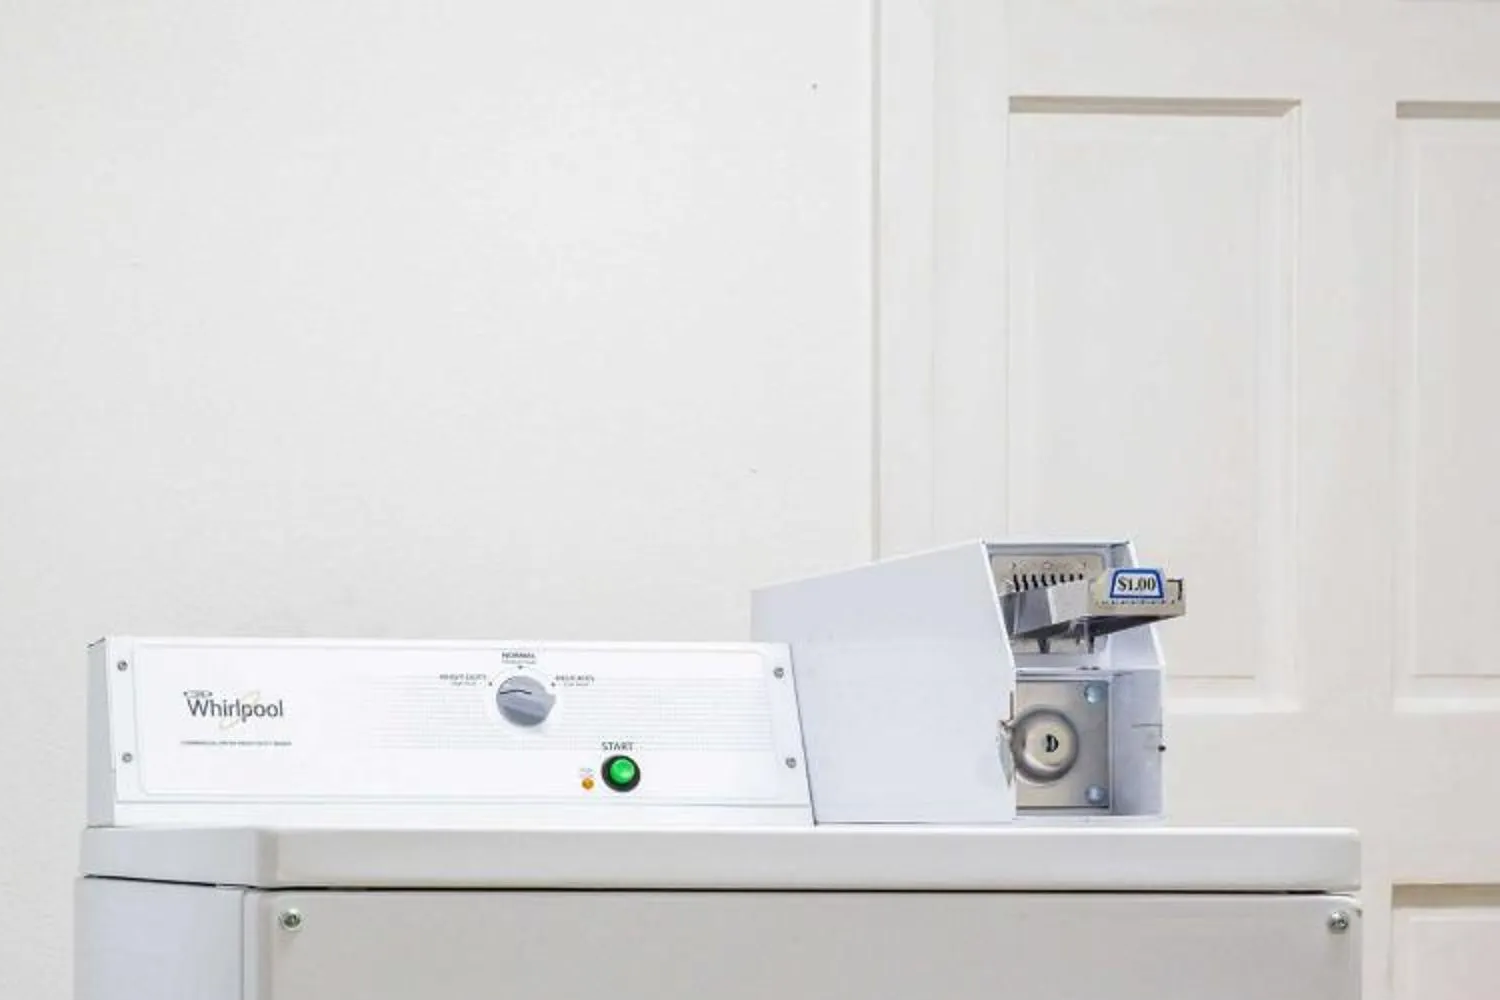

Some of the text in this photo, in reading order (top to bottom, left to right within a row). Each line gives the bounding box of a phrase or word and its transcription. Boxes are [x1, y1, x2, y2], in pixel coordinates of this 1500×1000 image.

[1118, 576, 1156, 592] $1.00
[186, 699, 284, 722] Whirlpool
[601, 741, 634, 751] START
